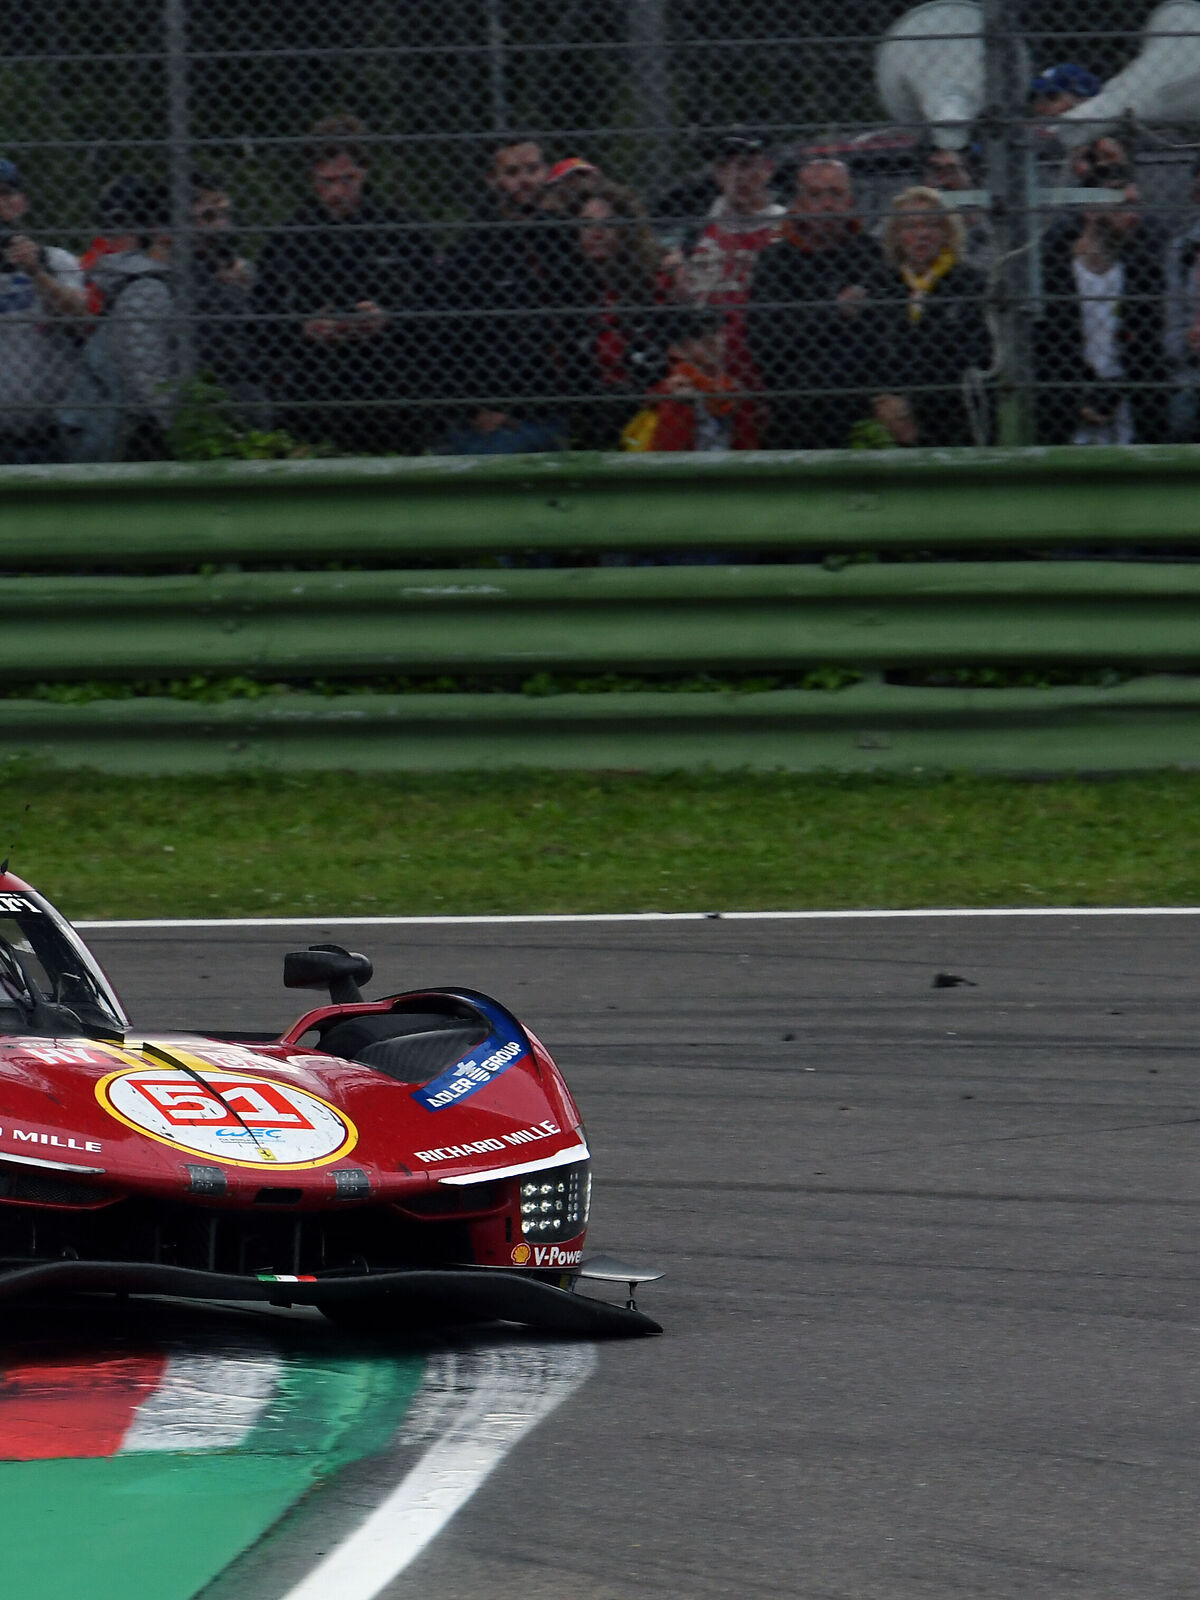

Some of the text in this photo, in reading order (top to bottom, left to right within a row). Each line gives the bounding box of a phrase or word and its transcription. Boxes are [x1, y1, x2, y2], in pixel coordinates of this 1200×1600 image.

[425, 1041, 522, 1108] ADLER GROUP
[149, 1081, 302, 1123] 51
[12, 1129, 102, 1153] MILLE
[215, 1127, 283, 1139] WEC
[413, 1119, 562, 1163] RICHARD MILLE
[533, 1246, 583, 1266] V-Powe
